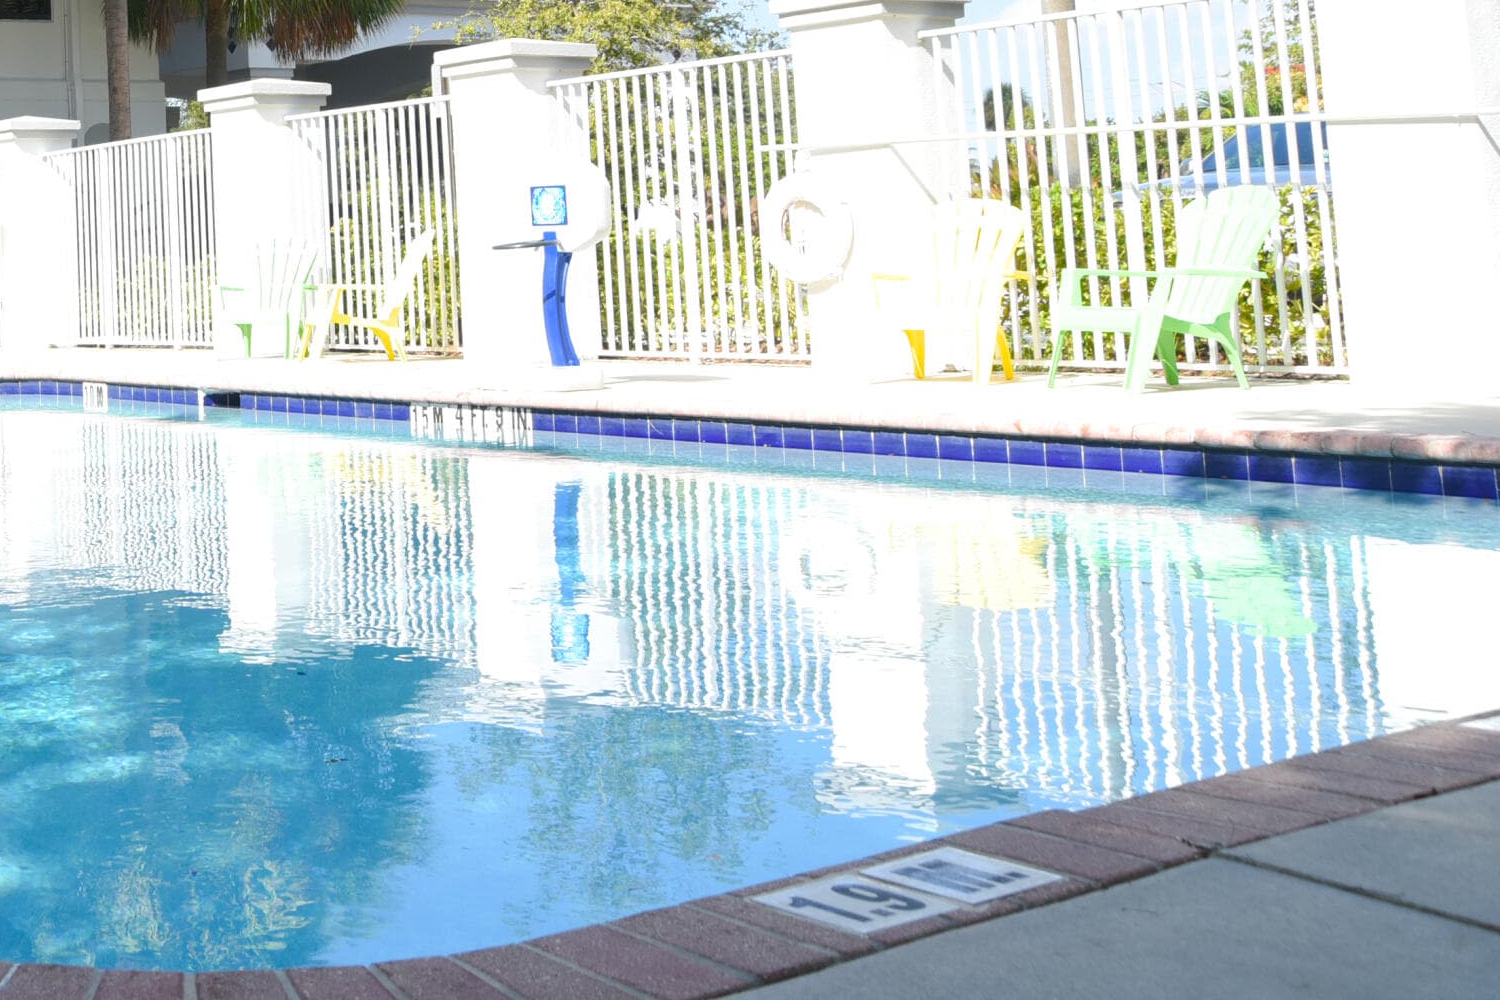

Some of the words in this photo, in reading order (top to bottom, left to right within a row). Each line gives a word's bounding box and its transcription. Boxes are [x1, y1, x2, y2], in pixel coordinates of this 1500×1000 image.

[455, 405, 463, 426] 4
[495, 407, 504, 428] 9
[790, 883, 926, 922] 1.9
